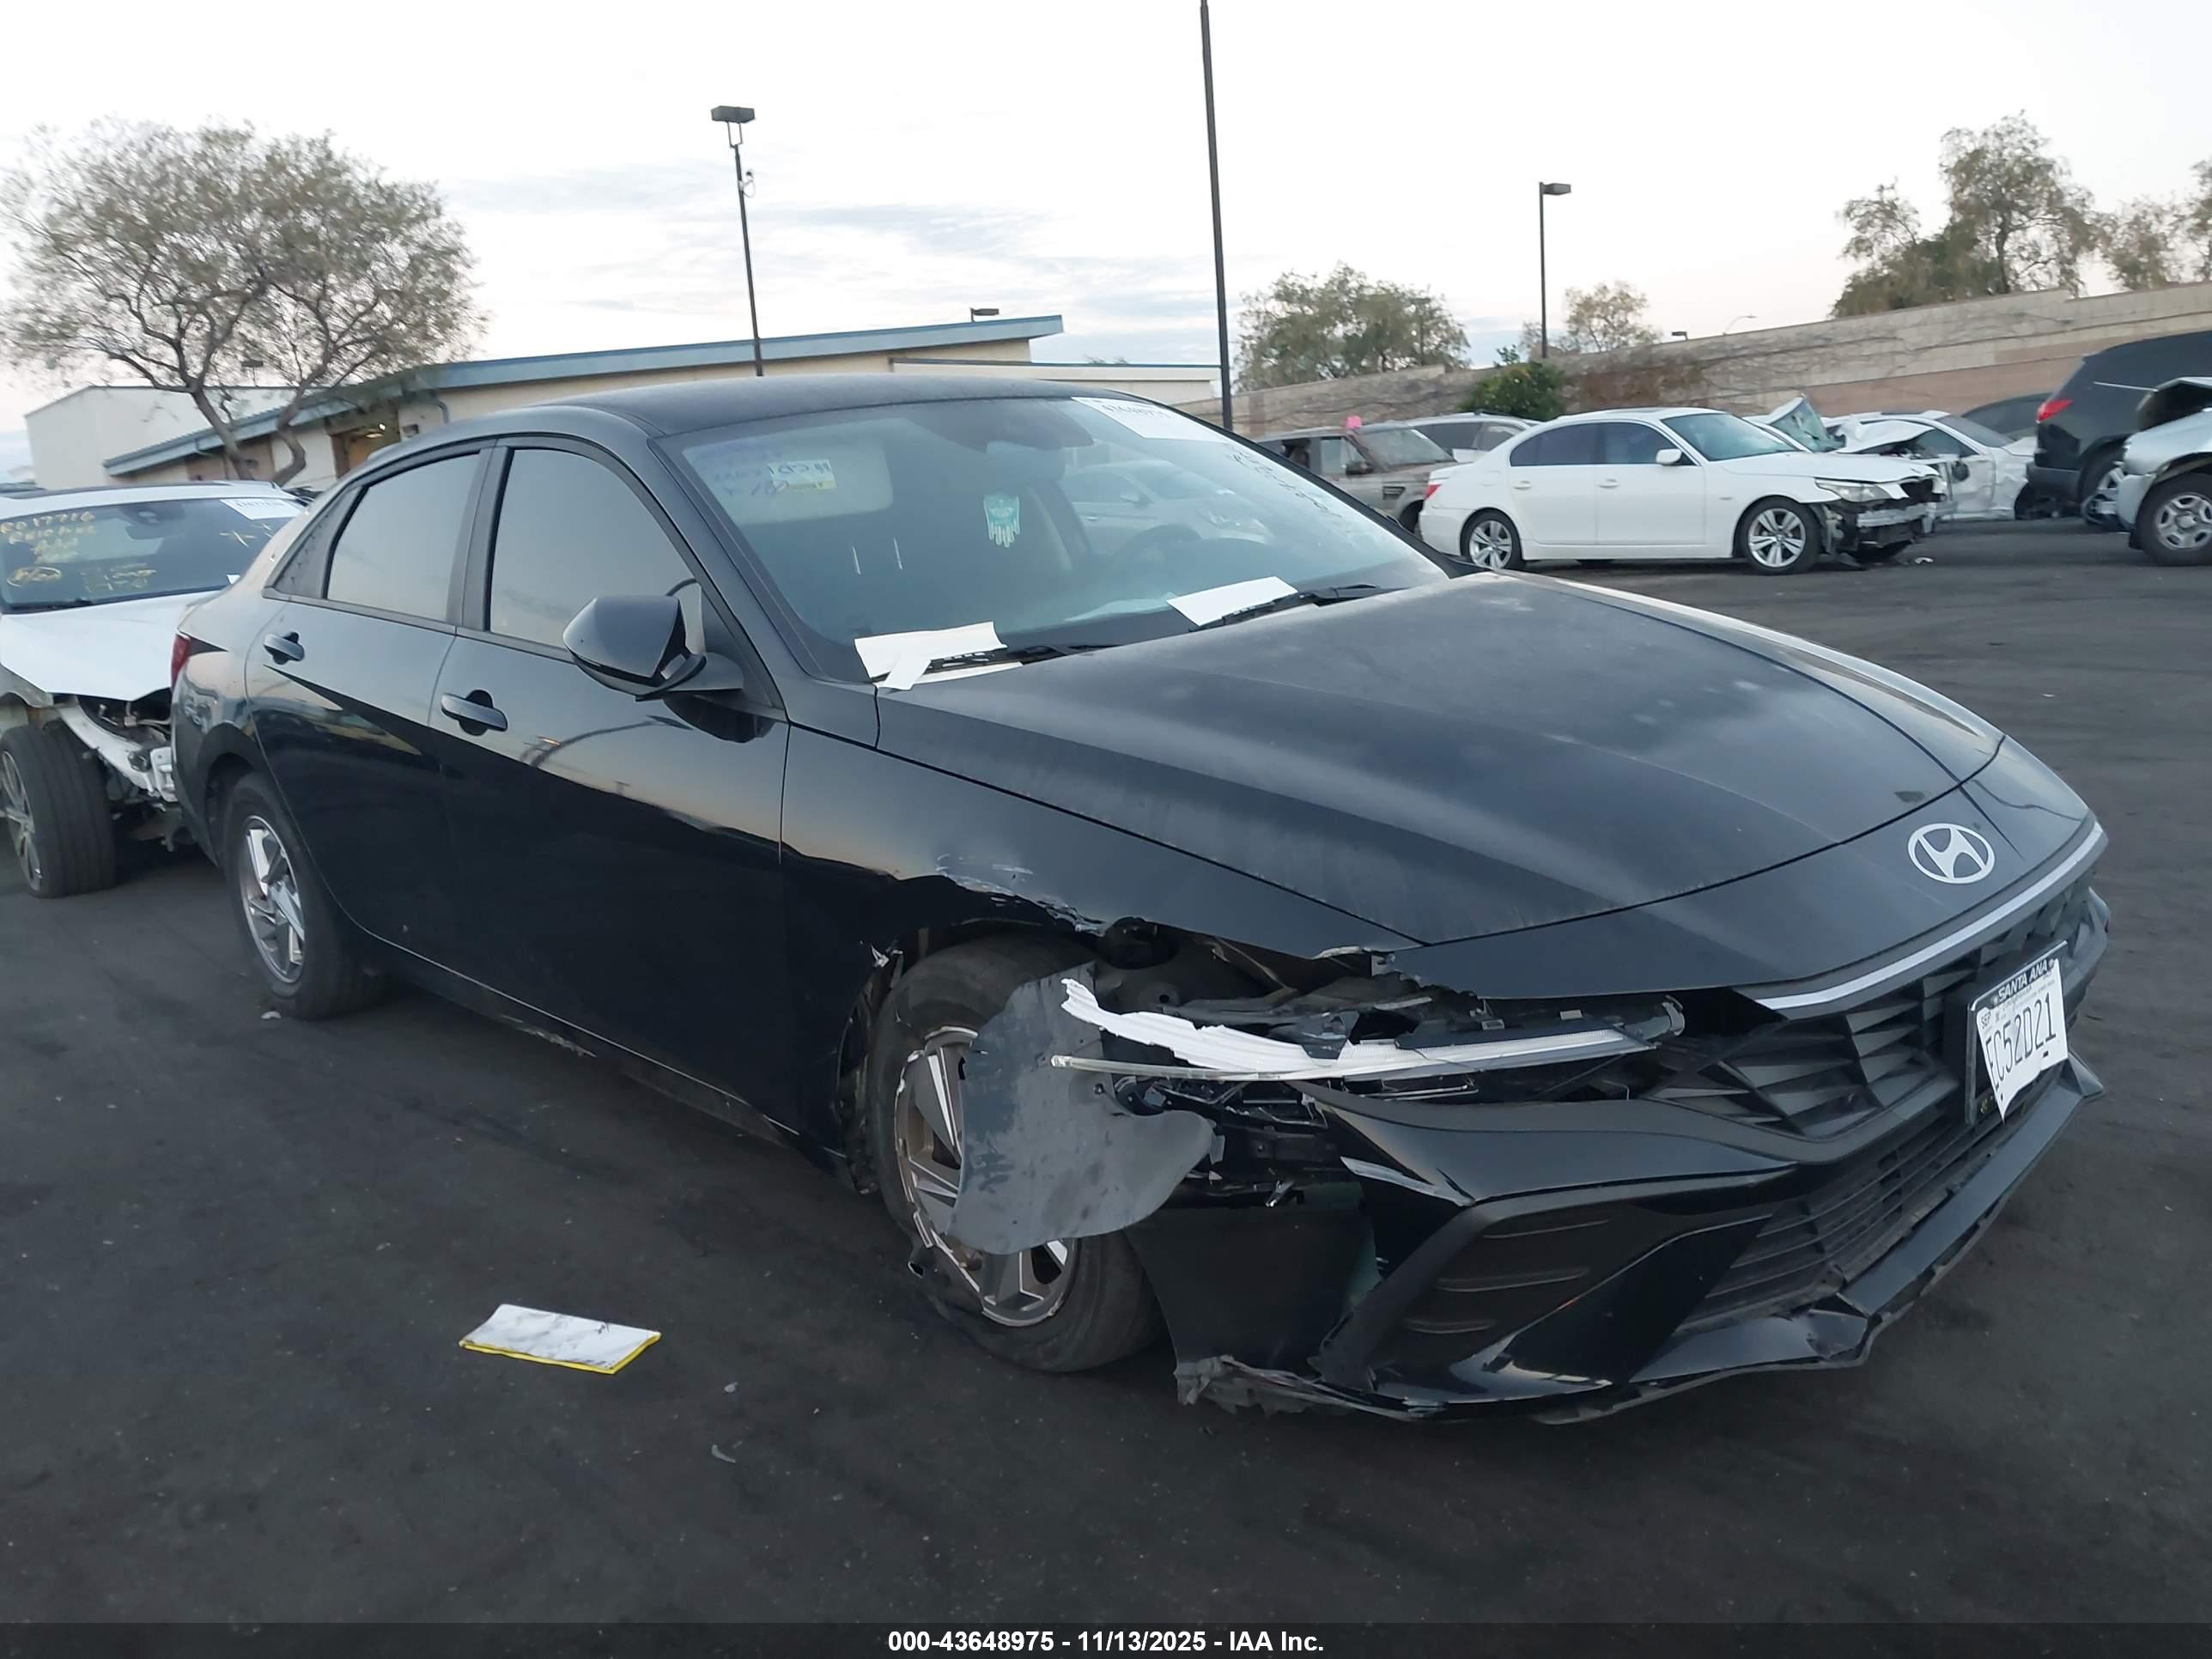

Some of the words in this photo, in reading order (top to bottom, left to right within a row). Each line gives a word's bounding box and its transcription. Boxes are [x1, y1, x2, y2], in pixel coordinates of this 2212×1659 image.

[1998, 973, 2027, 1002] SANTA
[2029, 959, 2047, 982] ANA
[1980, 1012, 1991, 1030] SEP
